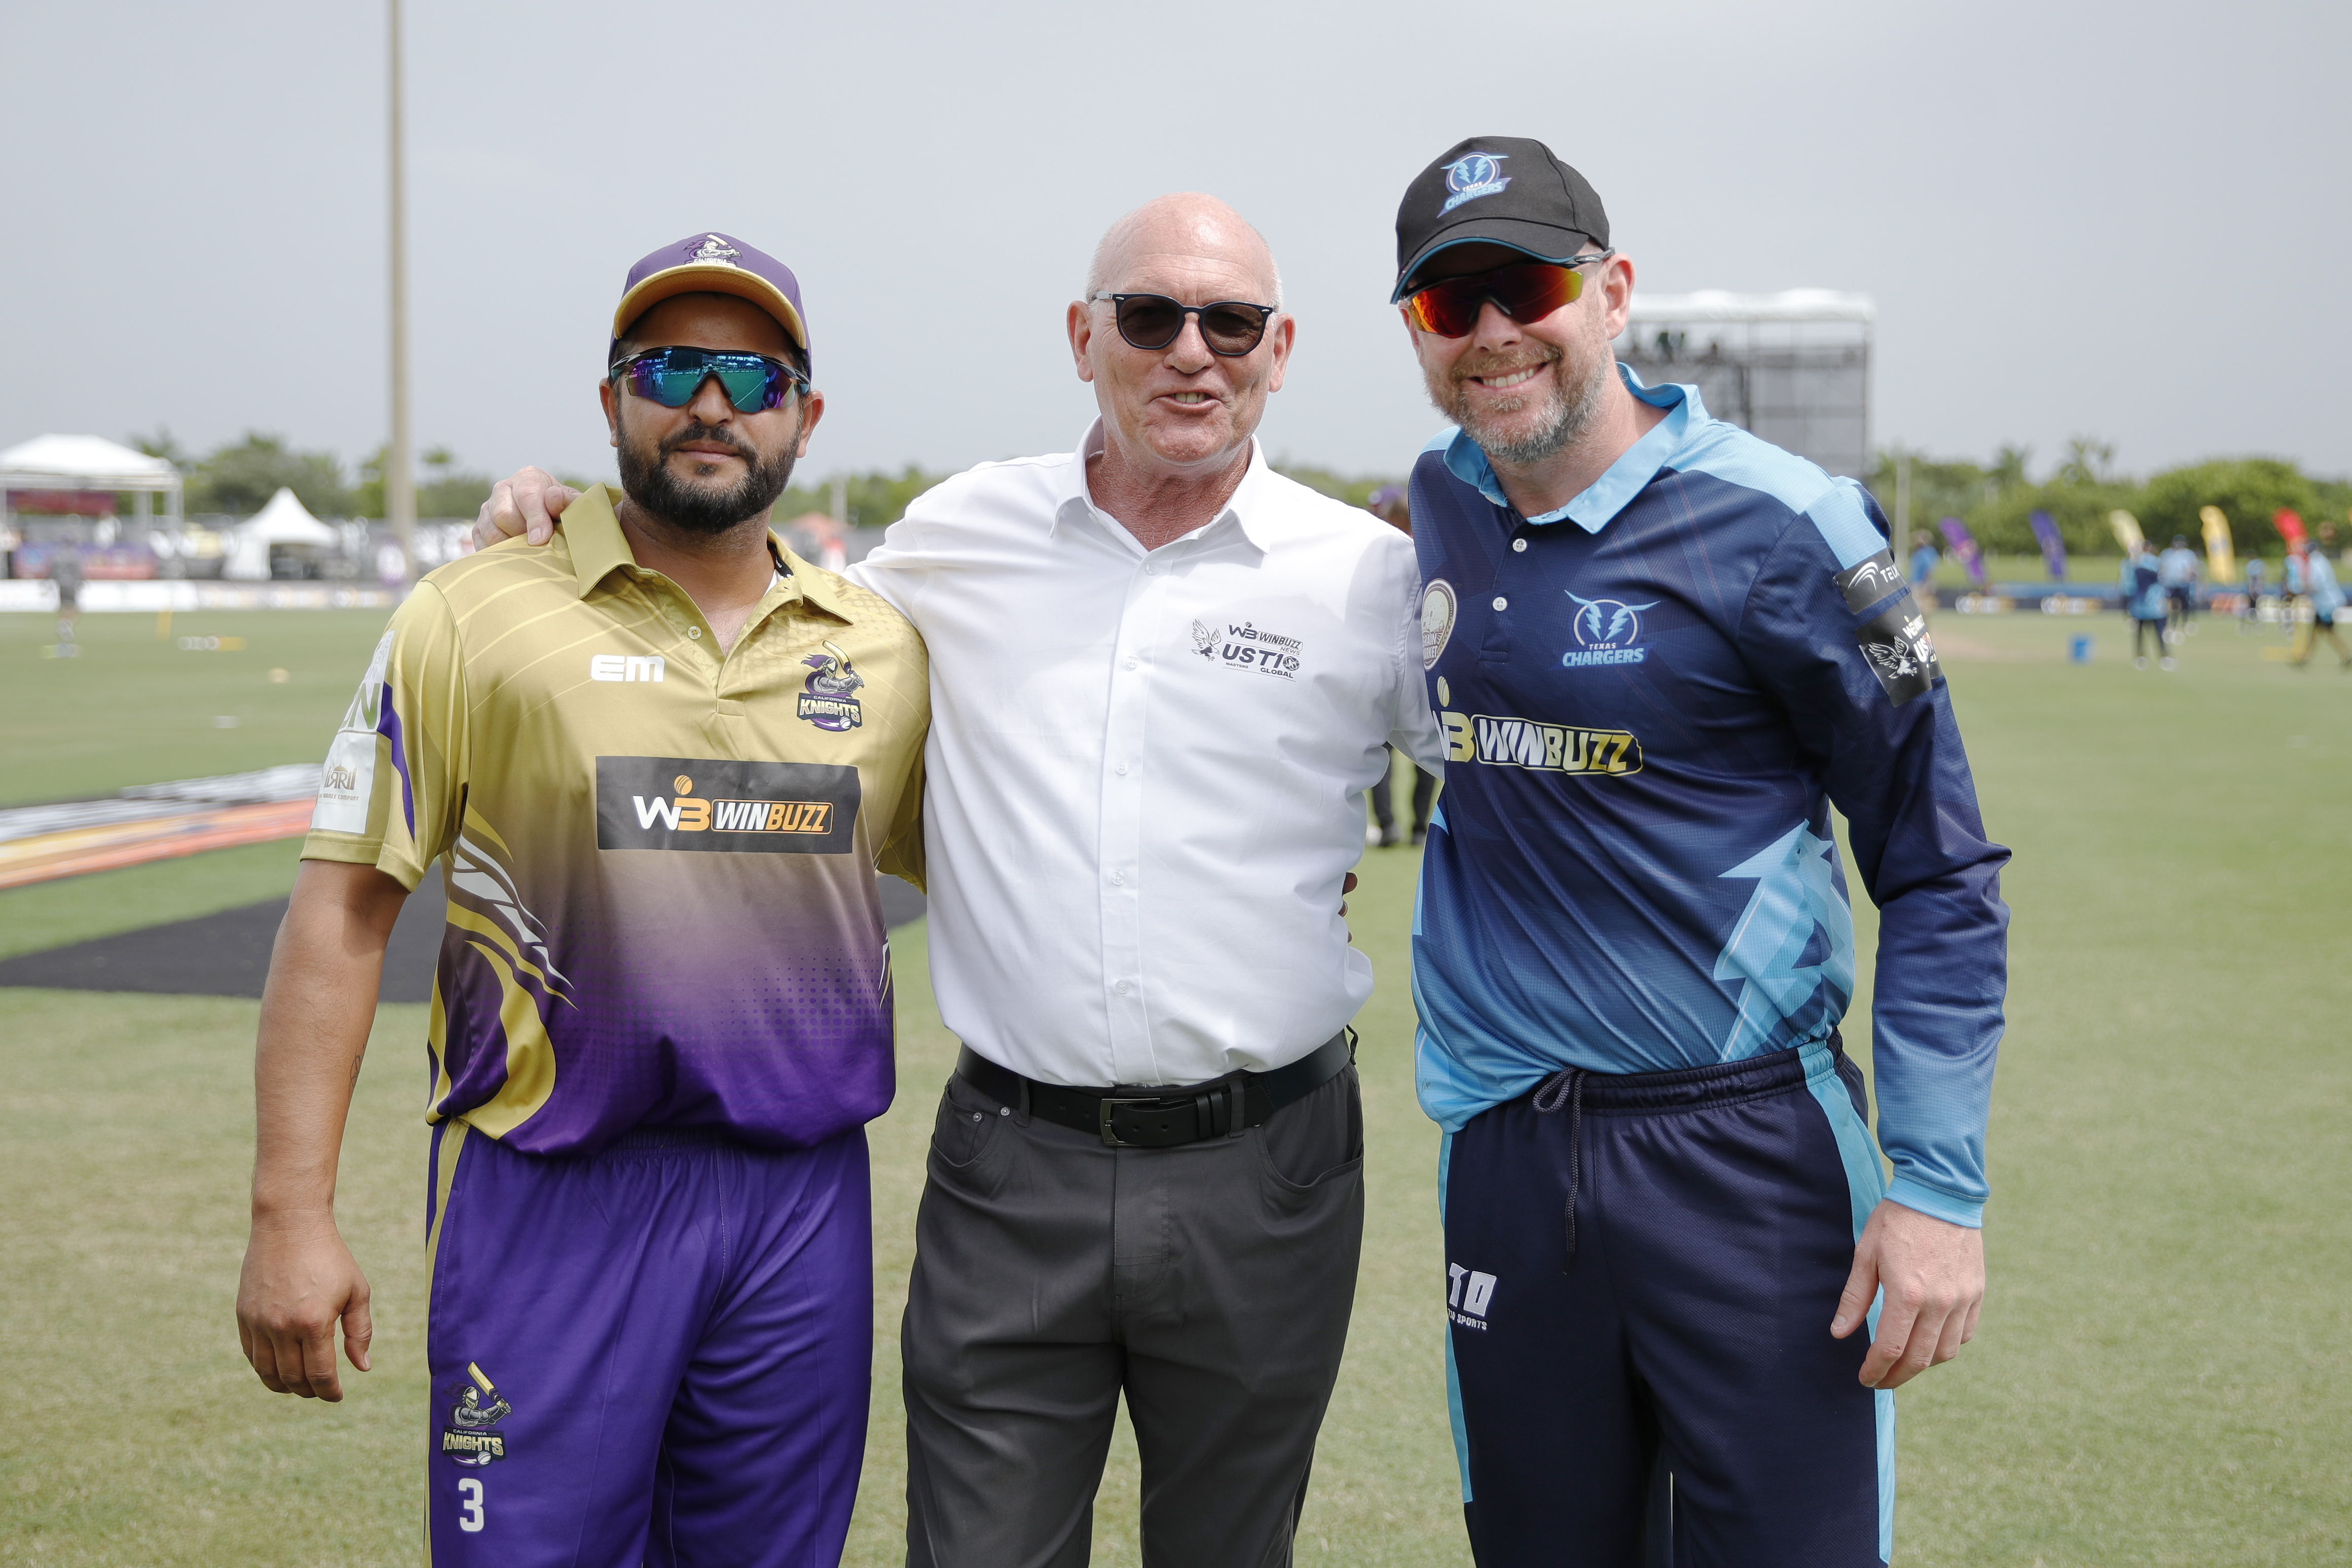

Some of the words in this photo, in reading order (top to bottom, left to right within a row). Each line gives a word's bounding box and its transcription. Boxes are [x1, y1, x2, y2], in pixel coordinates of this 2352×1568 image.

[1445, 181, 1502, 210] CHARGERS
[1462, 181, 1483, 192] TEXAS
[1258, 632, 1301, 649] WINBUZZ
[1589, 642, 1617, 650] TEXAS
[1280, 646, 1300, 655] NEWS
[1562, 648, 1644, 667] CHARGERS
[1260, 667, 1293, 678] GLOBAL
[799, 699, 860, 723] KNIGHTS
[1479, 718, 1633, 773] WINBUZZ
[714, 801, 830, 832] WINBUZZ
[1457, 1314, 1488, 1330] SPORTS
[443, 1432, 504, 1456] KNIGHTS
[458, 1477, 484, 1533] 3
